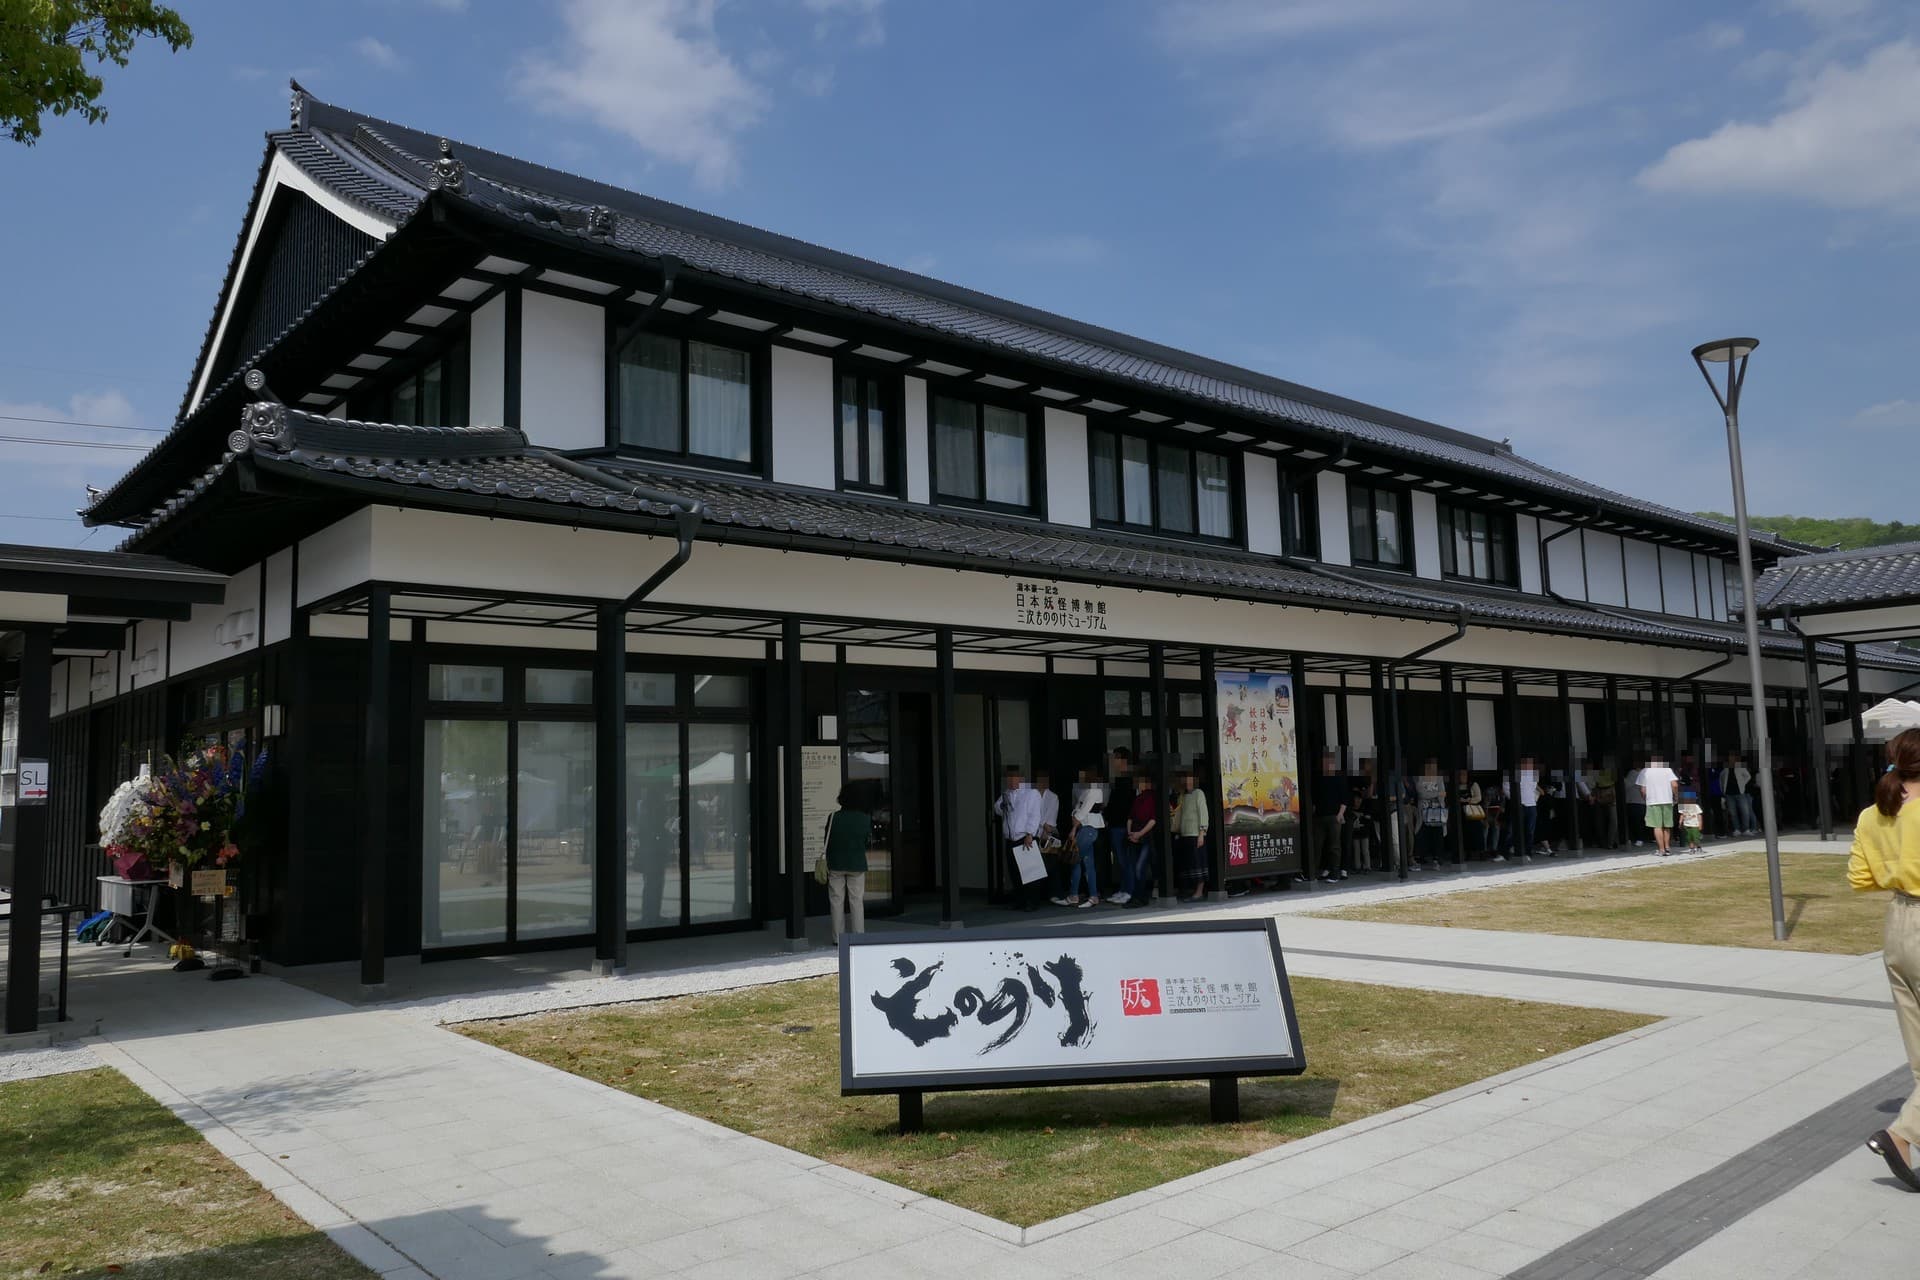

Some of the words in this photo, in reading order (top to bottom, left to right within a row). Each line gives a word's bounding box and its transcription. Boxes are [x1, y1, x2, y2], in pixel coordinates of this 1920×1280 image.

[1017, 594, 1106, 614] 日本妖怪博物館
[1017, 610, 1107, 630] 三次もののけミュージアム
[21, 770, 47, 786] SL
[1121, 978, 1151, 1008] 妖
[1165, 982, 1258, 996] 日本妖怪博物館
[1167, 993, 1260, 1007] 三次もののけミュージアム
